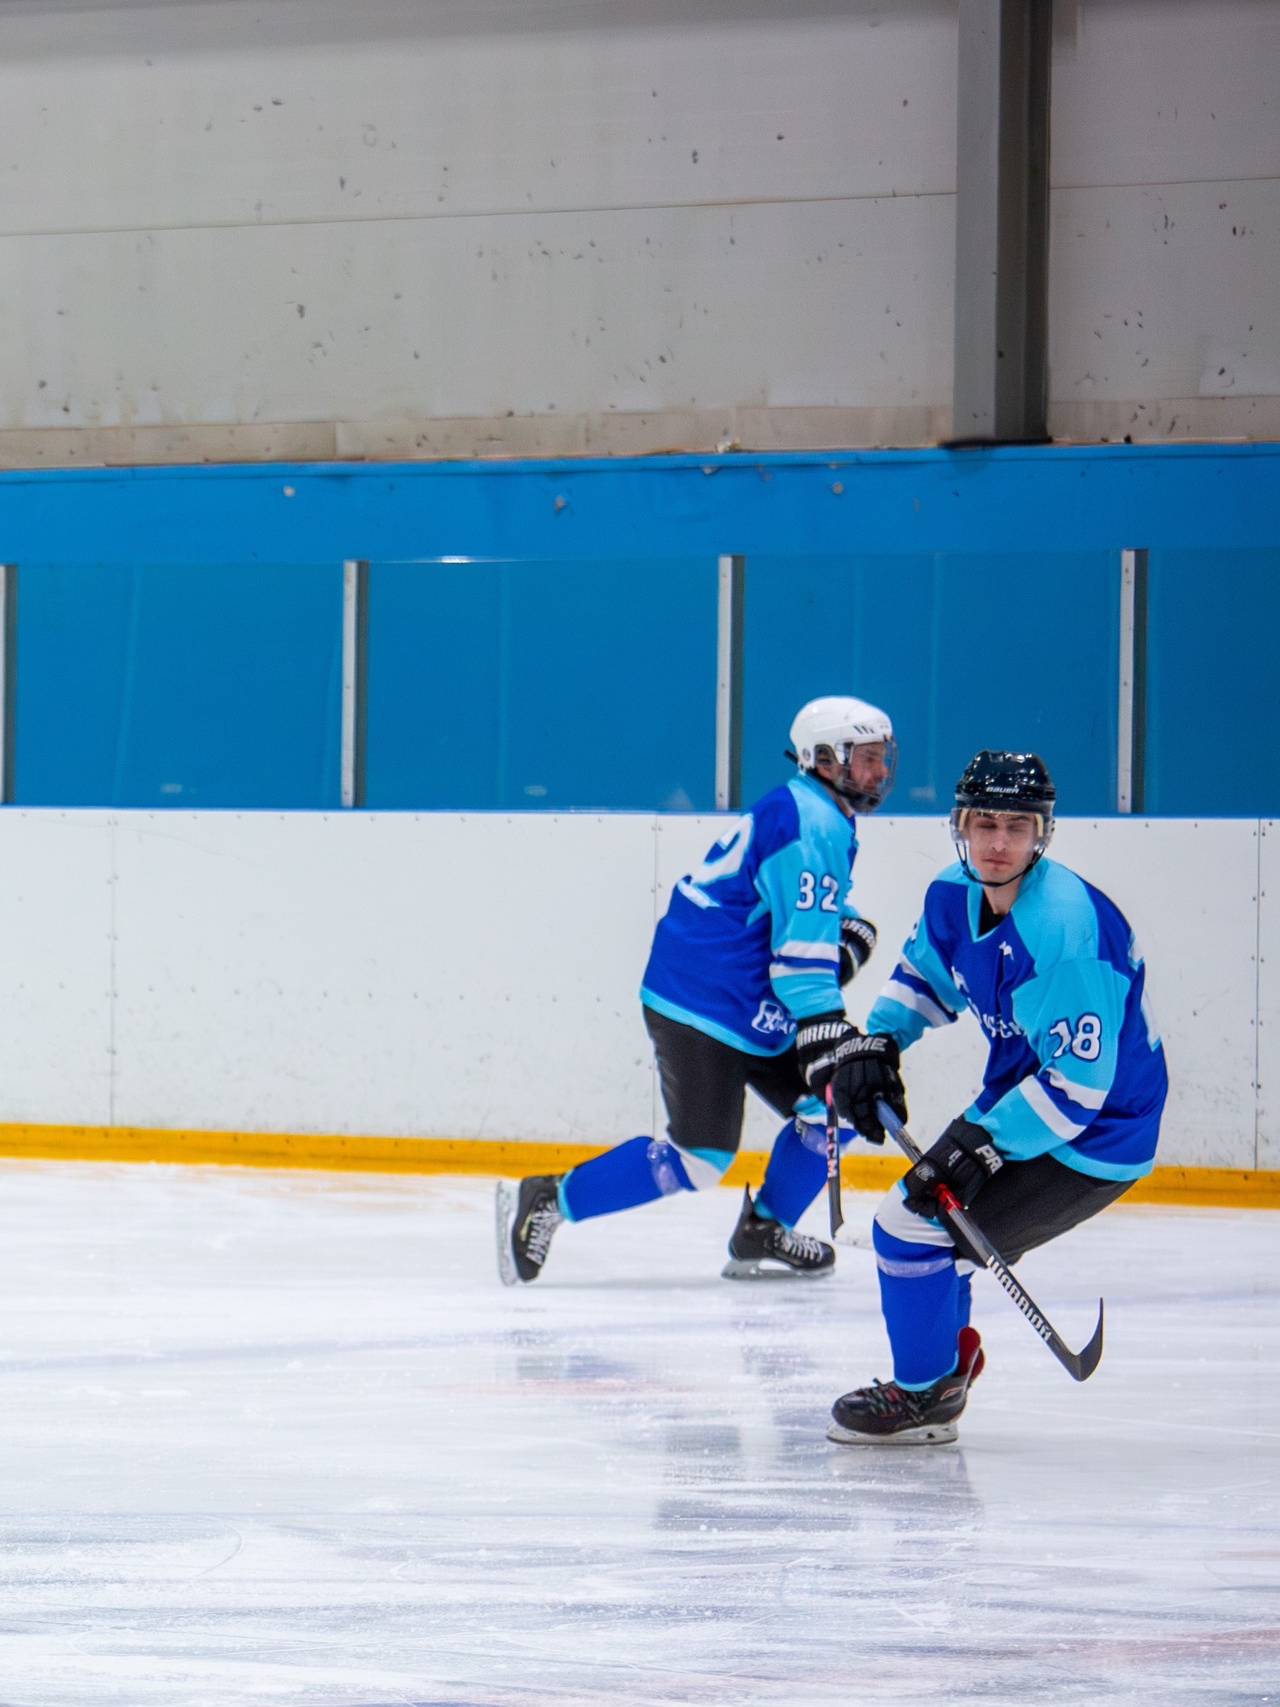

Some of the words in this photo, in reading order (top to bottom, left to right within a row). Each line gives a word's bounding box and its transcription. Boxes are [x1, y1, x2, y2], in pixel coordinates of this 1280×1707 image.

[795, 870, 840, 912] 32
[1049, 1013, 1103, 1062] 18
[985, 1254, 1052, 1344] WARRIOR
